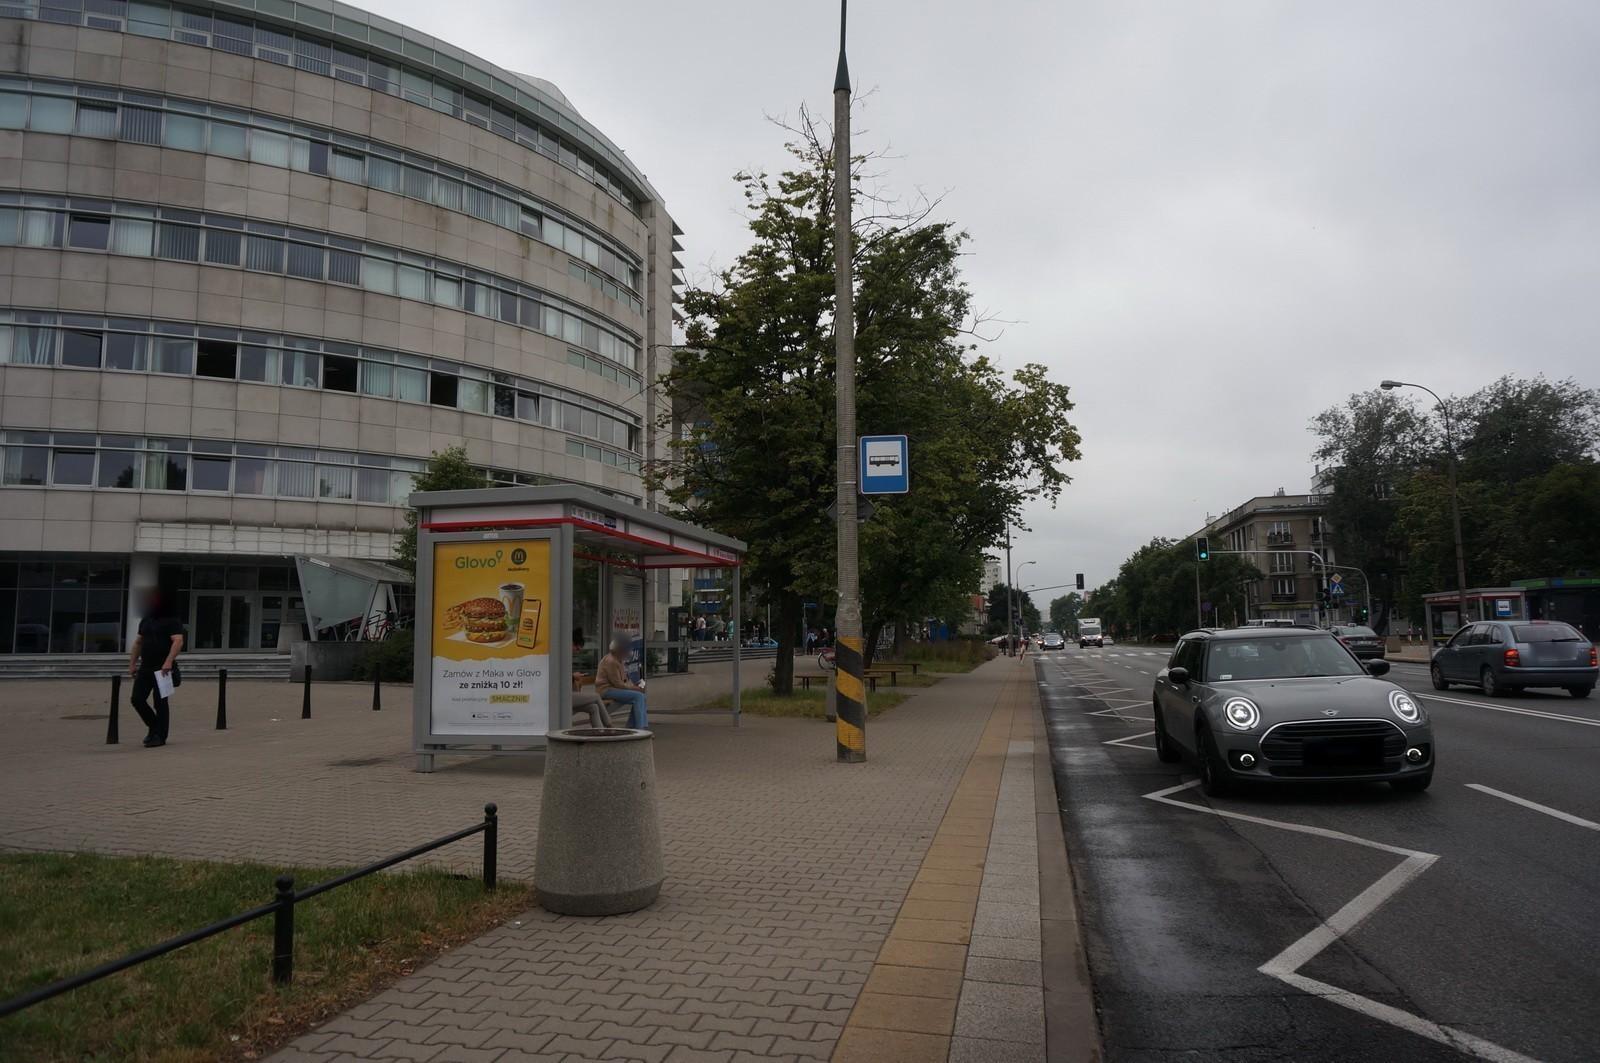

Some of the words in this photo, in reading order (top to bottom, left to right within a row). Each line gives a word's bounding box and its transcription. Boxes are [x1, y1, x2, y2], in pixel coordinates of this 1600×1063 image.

[455, 556, 497, 569] Glovo
[443, 669, 473, 678] Zamów
[516, 668, 541, 677] Glovo
[471, 681, 498, 690] zniżką
[512, 680, 523, 688] zł!
